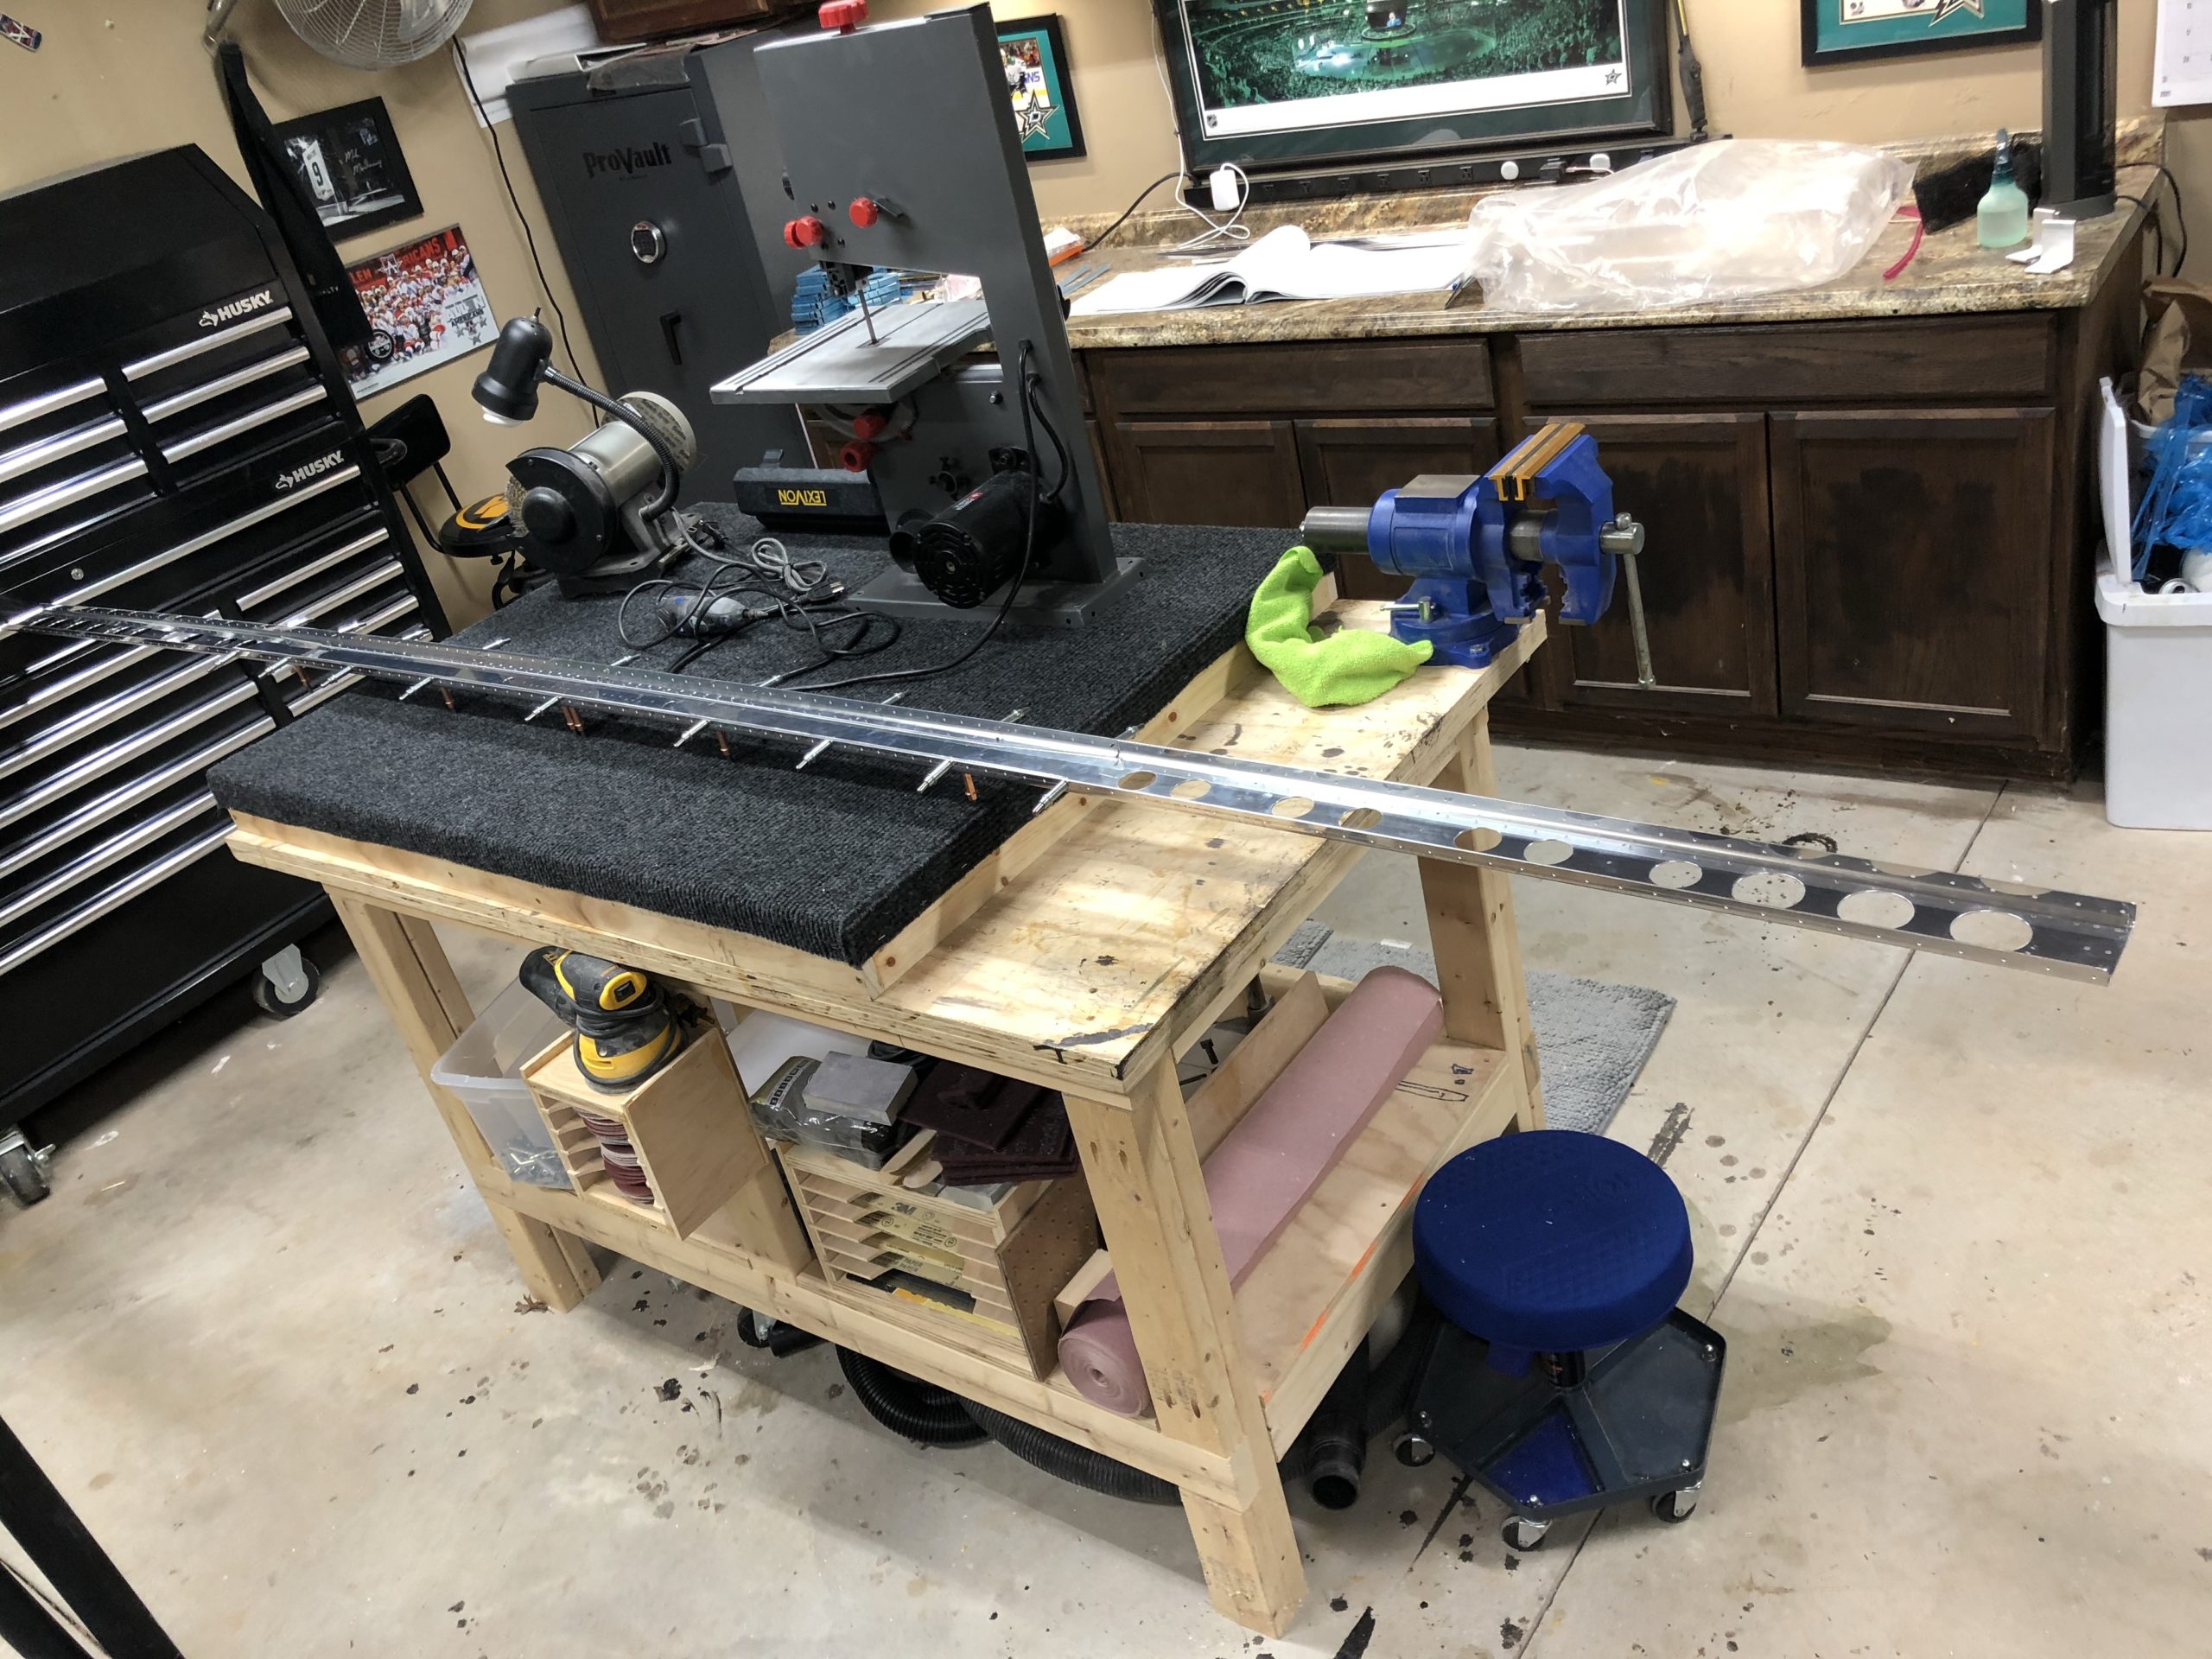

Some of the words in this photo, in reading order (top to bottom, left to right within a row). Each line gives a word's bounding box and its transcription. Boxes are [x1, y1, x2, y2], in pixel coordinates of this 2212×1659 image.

[582, 142, 672, 178] ProVault
[312, 162, 323, 186] 9
[217, 290, 270, 321] HUSKY
[292, 450, 341, 482] HUSKY
[779, 489, 827, 506] LEXIVON
[895, 1202, 917, 1216] 3M
